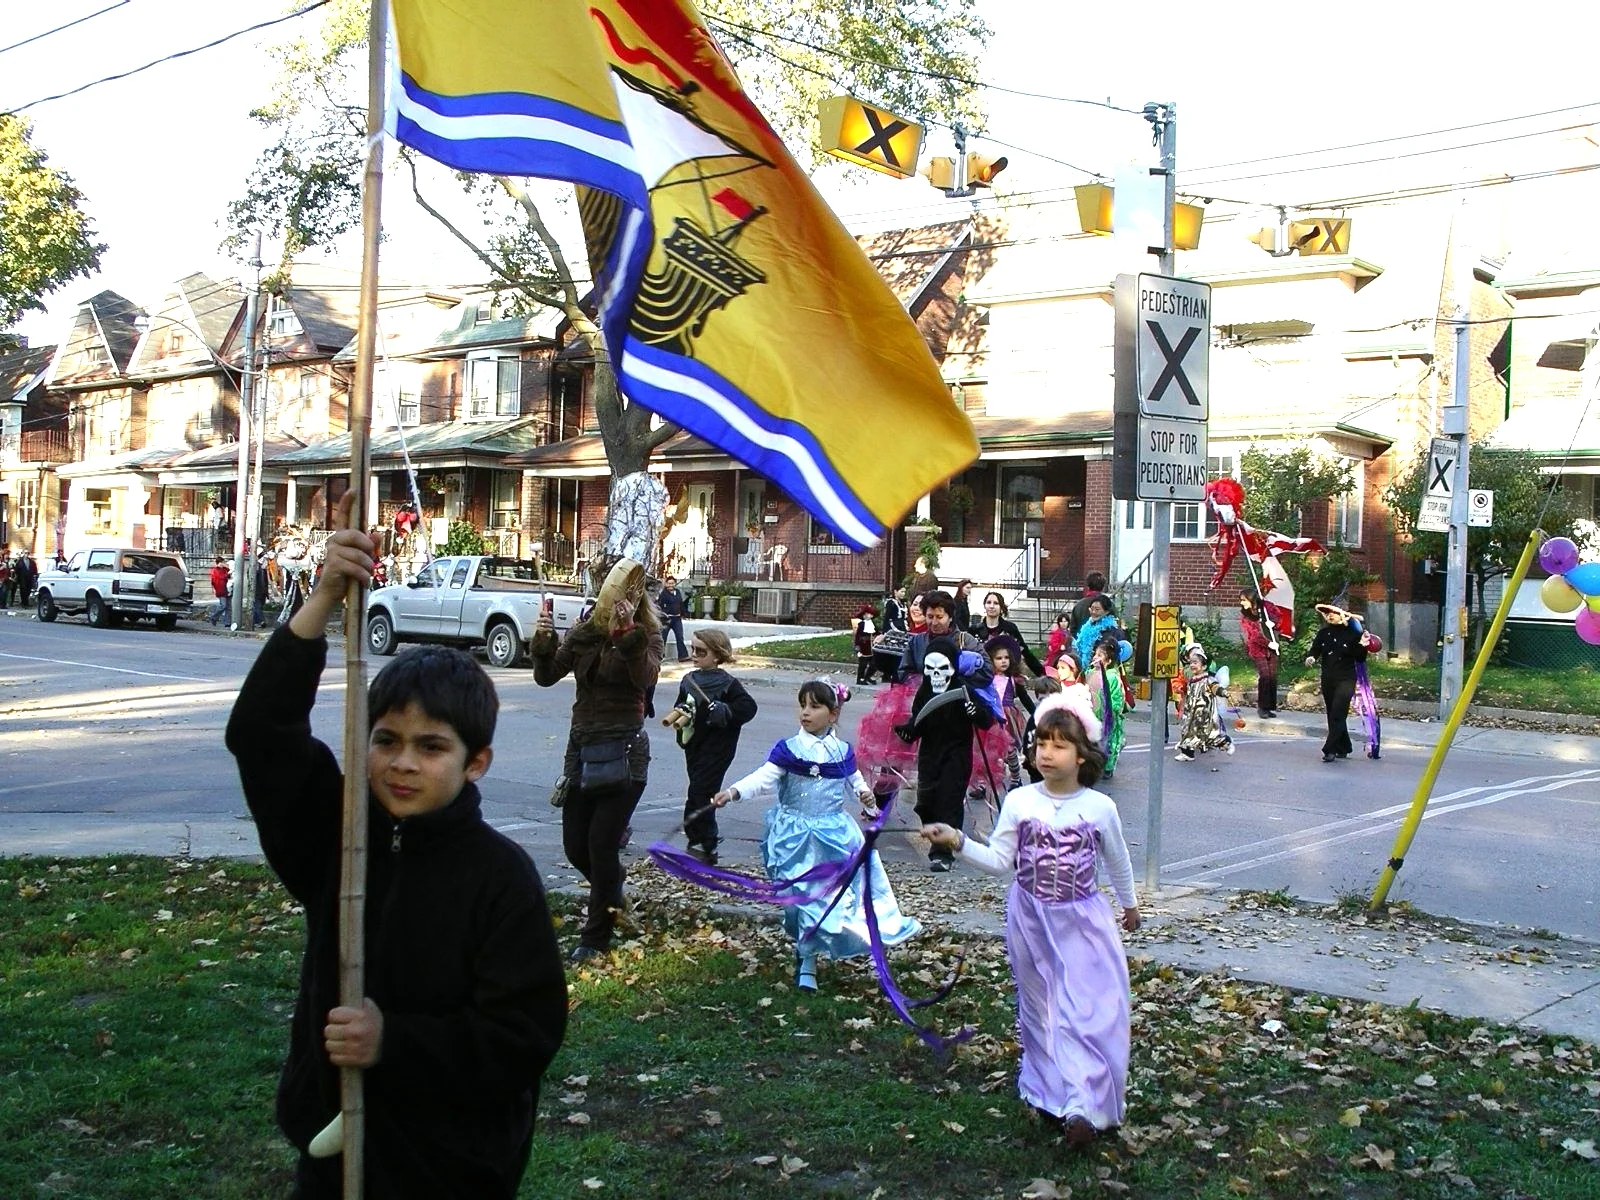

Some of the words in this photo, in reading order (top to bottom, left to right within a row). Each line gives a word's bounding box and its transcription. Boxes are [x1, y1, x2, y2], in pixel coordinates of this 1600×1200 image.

[854, 106, 910, 168] X
[1320, 221, 1345, 252] X
[1142, 289, 1207, 319] PEDESTRIAN
[1145, 320, 1202, 406] X
[1151, 430, 1175, 453] STOP
[1180, 433, 1197, 455] FOR
[1140, 461, 1206, 486] PEDESTRIANS
[1429, 457, 1454, 492] X
[1158, 633, 1176, 643] LOOK
[1156, 664, 1176, 675] POINT
